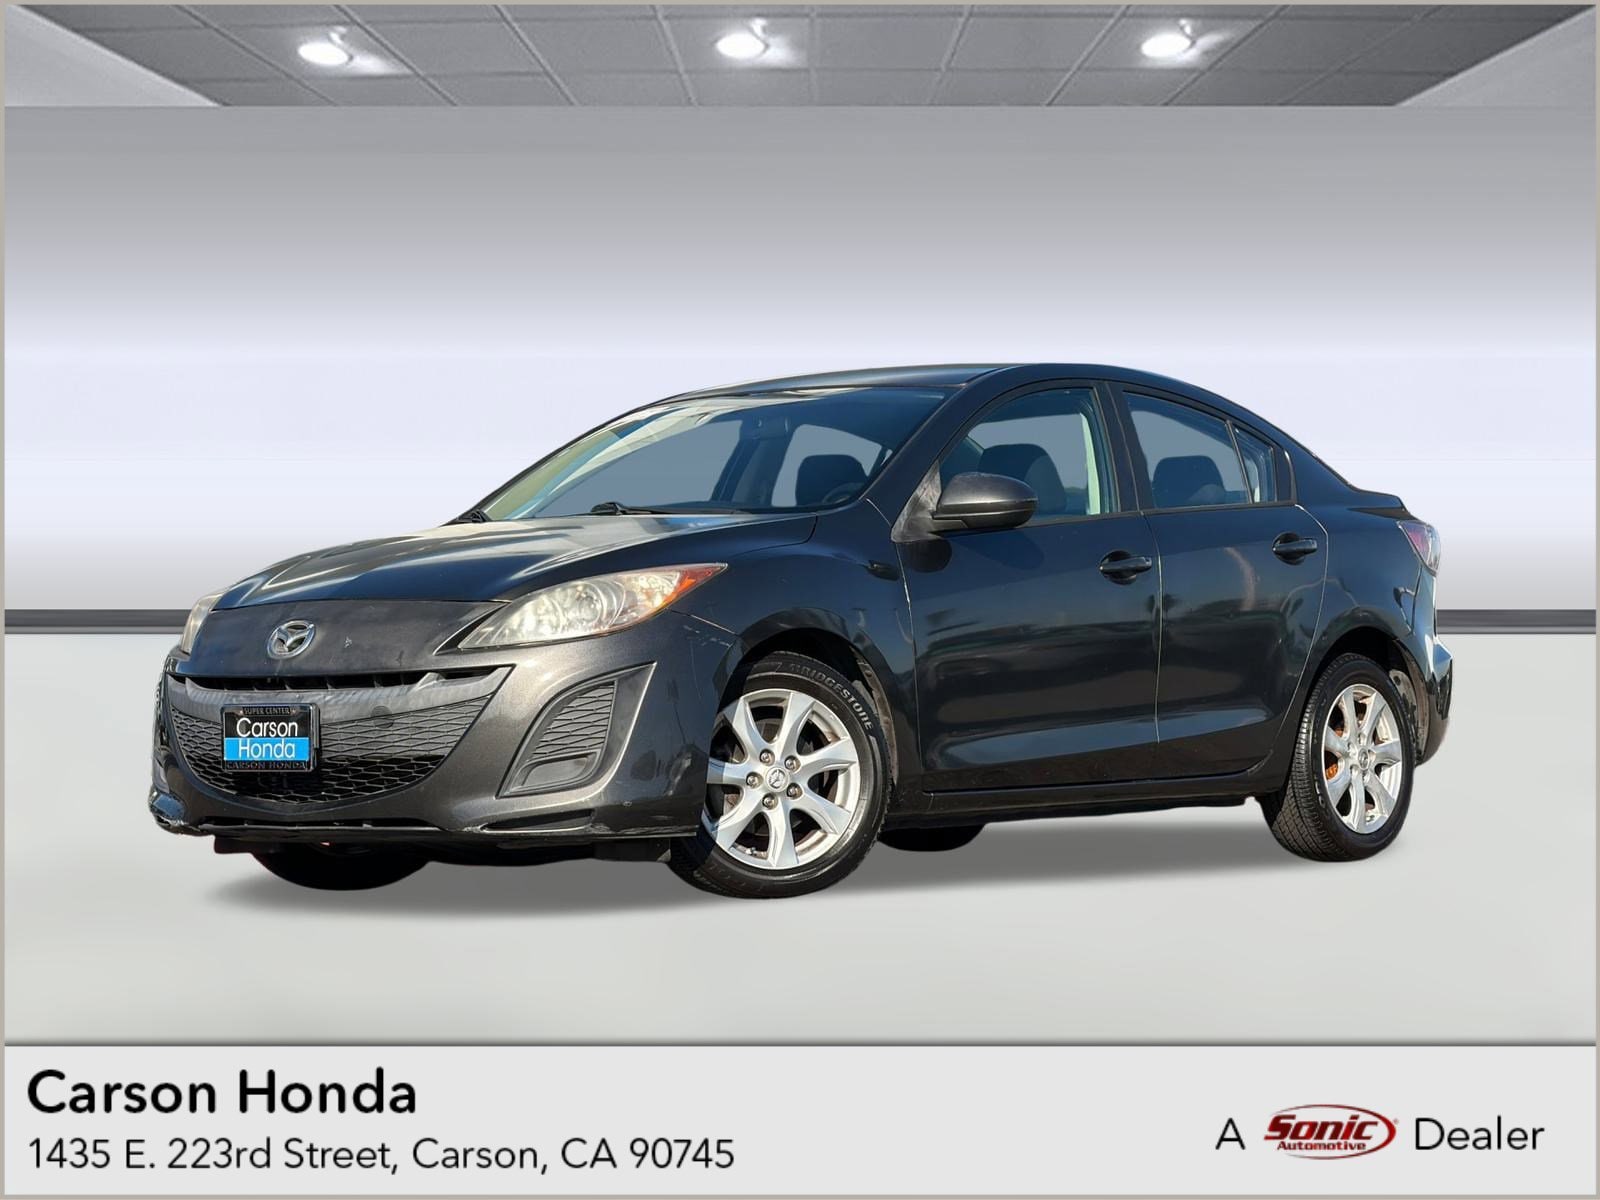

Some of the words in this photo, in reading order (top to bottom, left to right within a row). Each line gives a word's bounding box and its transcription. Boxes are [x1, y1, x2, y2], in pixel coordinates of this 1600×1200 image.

[789, 662, 874, 730] BRIDGESTONE
[265, 706, 291, 715] CENTER
[236, 717, 298, 737] Carson
[238, 738, 296, 758] Honda
[226, 761, 265, 769] CARSON
[269, 761, 307, 769] HONDA
